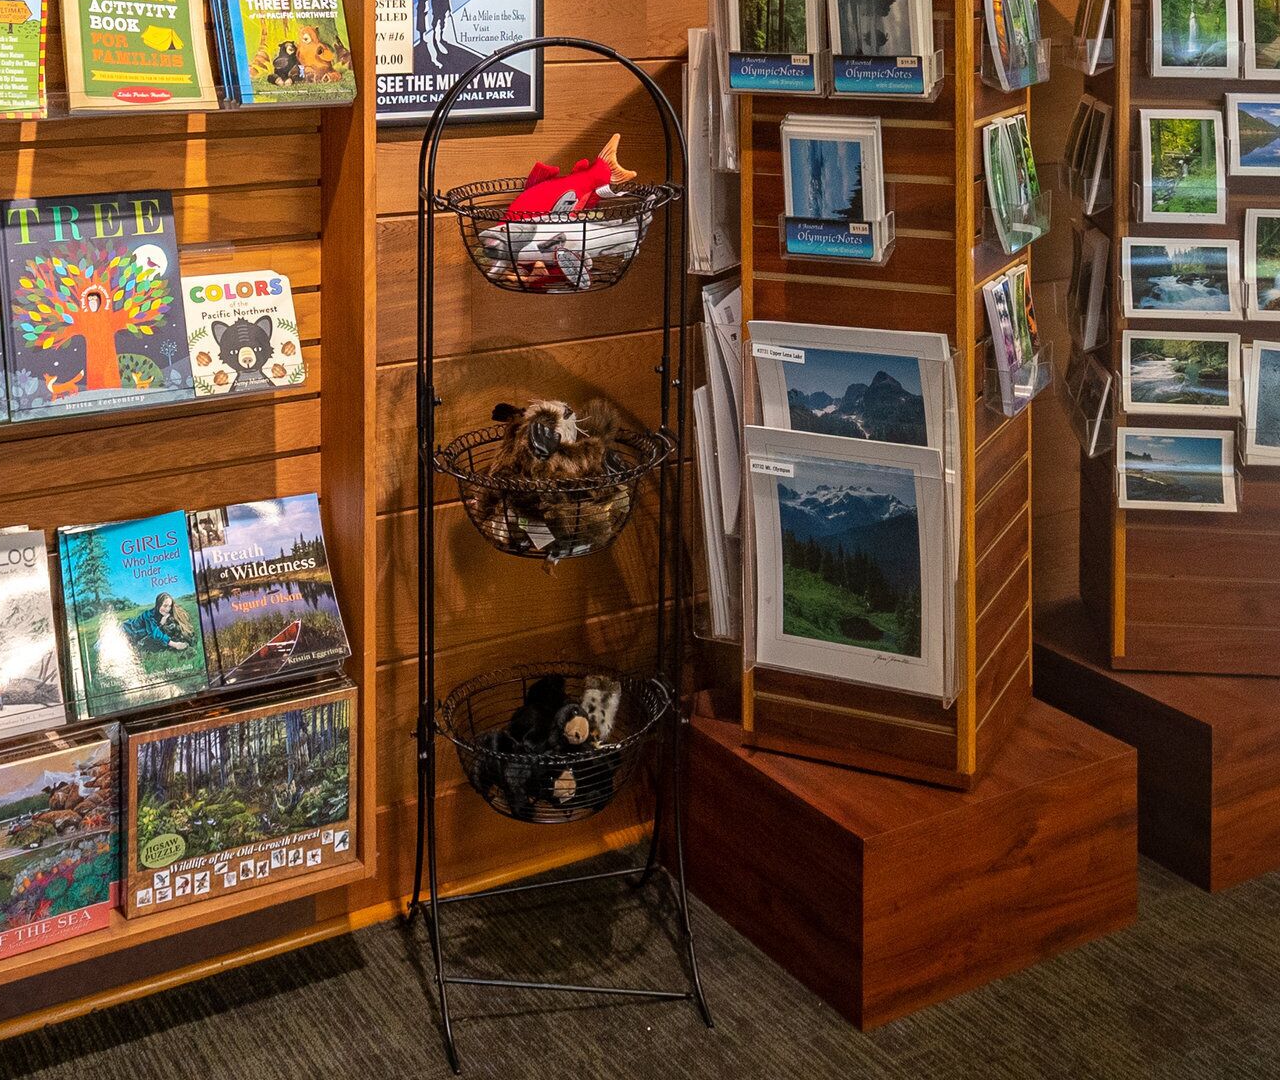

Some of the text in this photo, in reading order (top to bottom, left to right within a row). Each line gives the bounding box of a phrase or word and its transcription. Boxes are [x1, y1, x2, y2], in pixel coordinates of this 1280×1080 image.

[89, 0, 178, 19] ACTIVITY
[90, 16, 140, 33] BOOK
[473, 24, 489, 32] Visit
[91, 32, 128, 49] FOR
[460, 31, 523, 43] Hurricane Ridge
[92, 48, 184, 68] FAMILIES
[741, 65, 805, 77] OlympicNotes
[845, 68, 912, 79] OlympicNotes
[377, 72, 514, 93] SEE THE WAY
[377, 91, 514, 105] OLYMPIC PARK
[8, 198, 165, 245] TREE
[797, 232, 863, 245] OlympicNotes
[190, 277, 282, 305] COLORS
[201, 305, 278, 321] Pacific Northwest
[121, 530, 178, 556] GIRLS
[121, 547, 181, 569] Who Looked
[213, 543, 264, 564] Breath
[133, 566, 162, 580] Under
[220, 555, 317, 582] of Wilderness
[151, 573, 178, 588] Rocks
[169, 829, 321, 875] Wildlife of the Old-Growth Forest
[14, 924, 47, 945] THE
[51, 909, 92, 933] SEA
